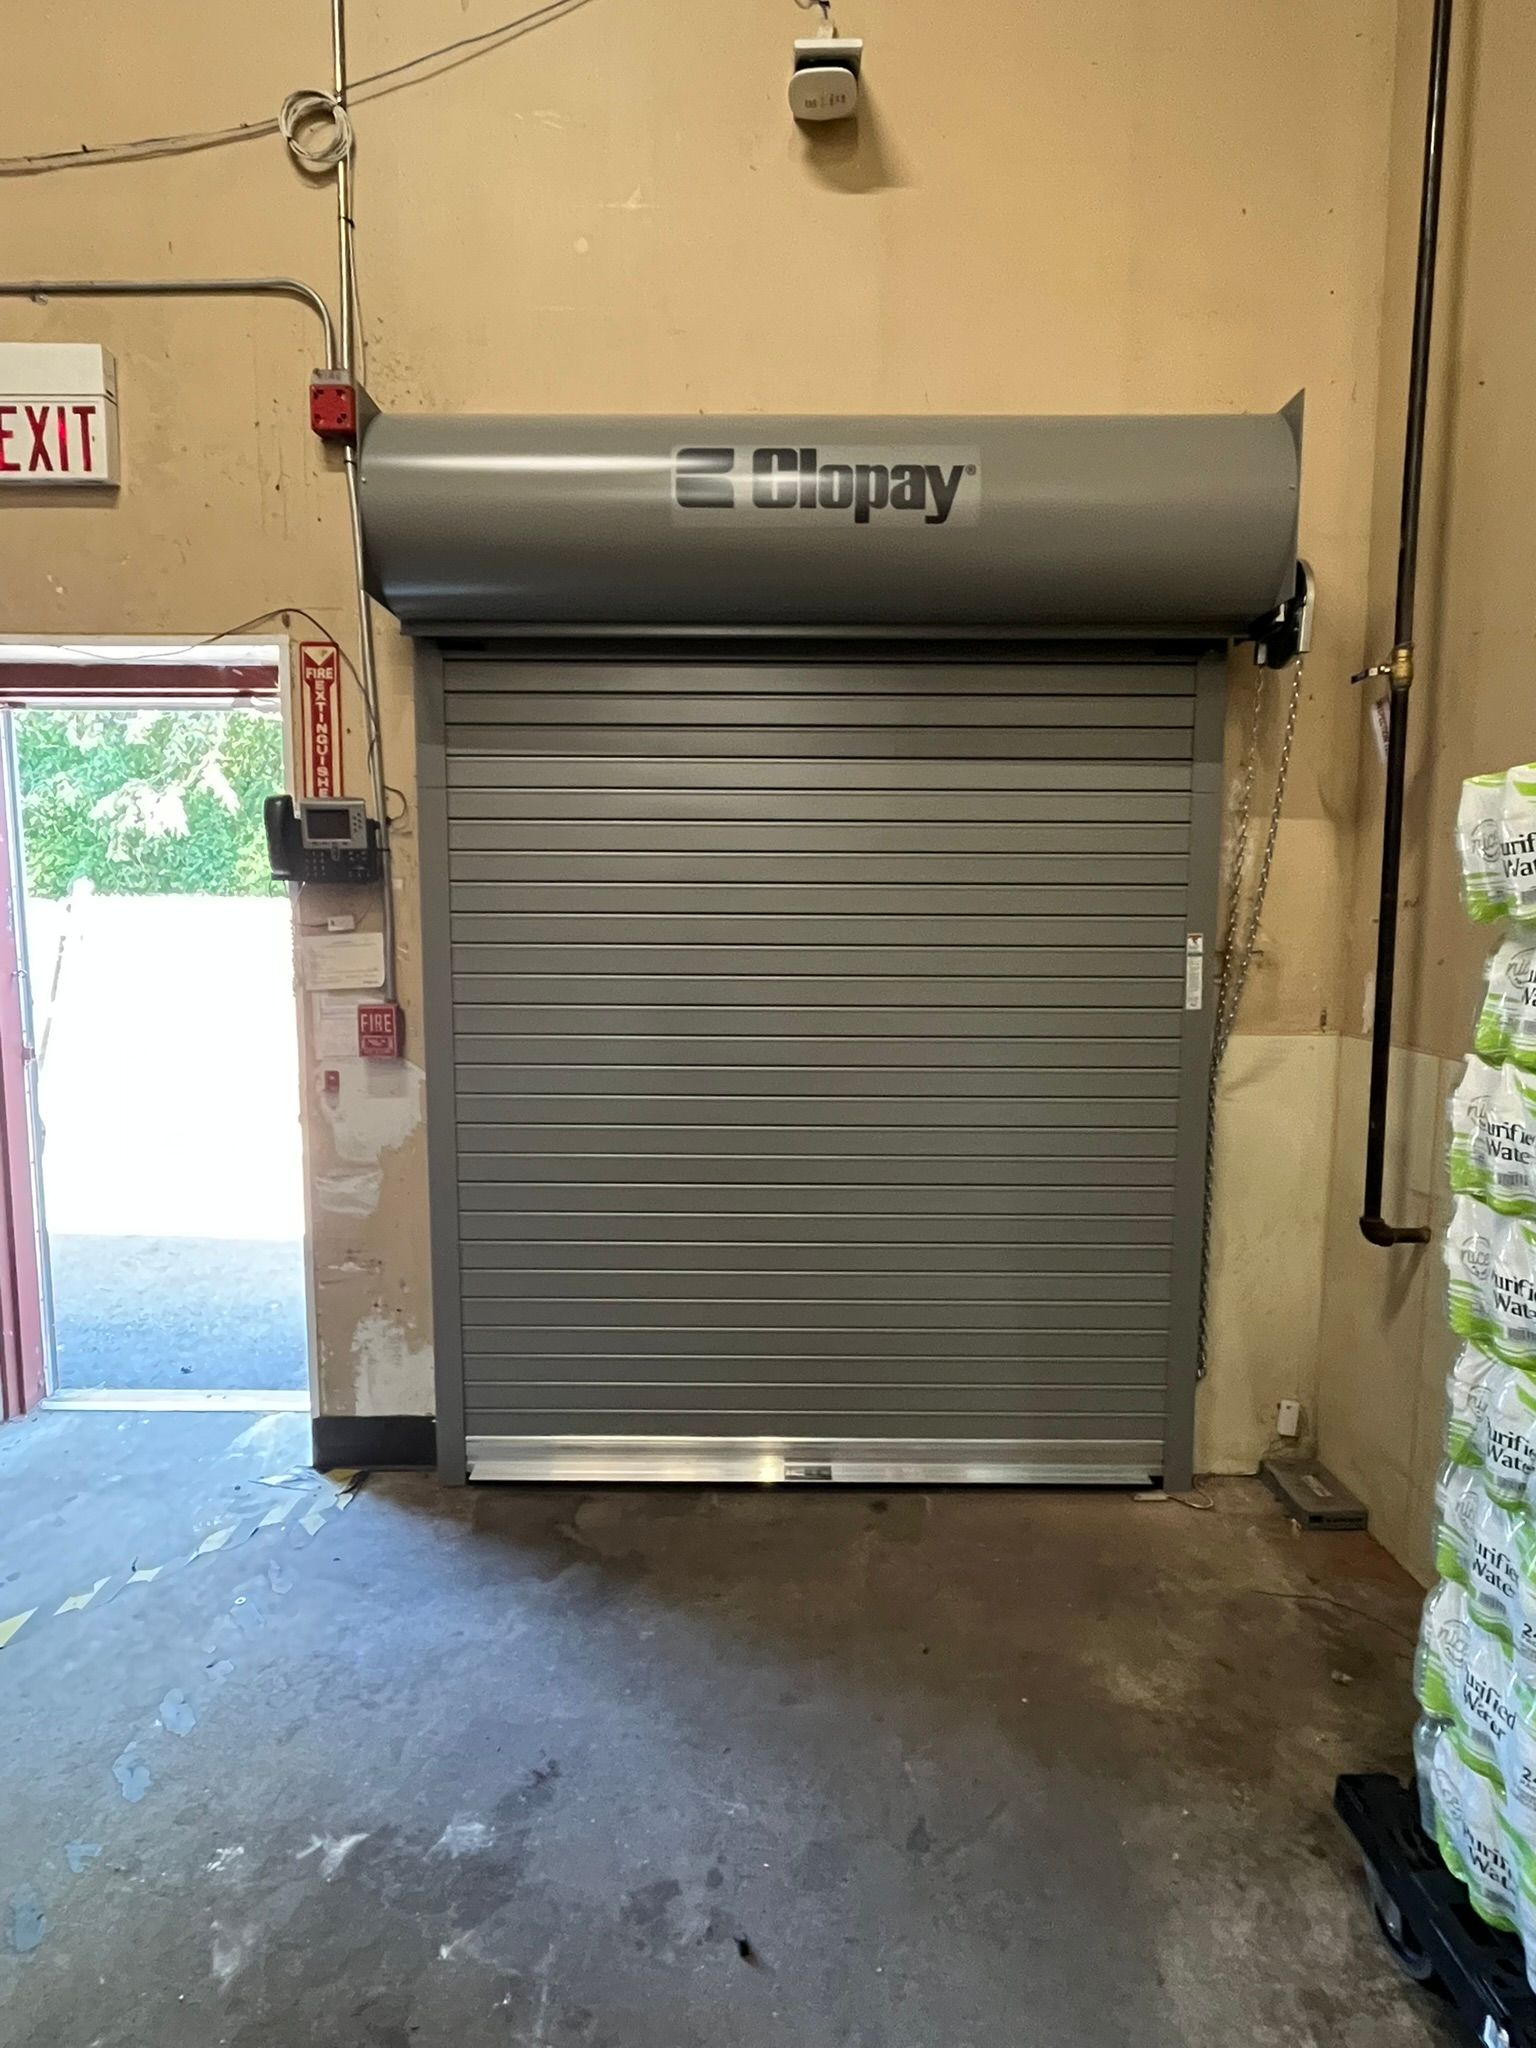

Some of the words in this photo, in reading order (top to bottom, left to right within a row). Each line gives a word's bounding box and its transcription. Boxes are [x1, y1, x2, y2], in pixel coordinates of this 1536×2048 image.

[0, 406, 96, 472] EXIT
[305, 667, 334, 680] FIRE
[360, 1013, 392, 1032] FIRE
